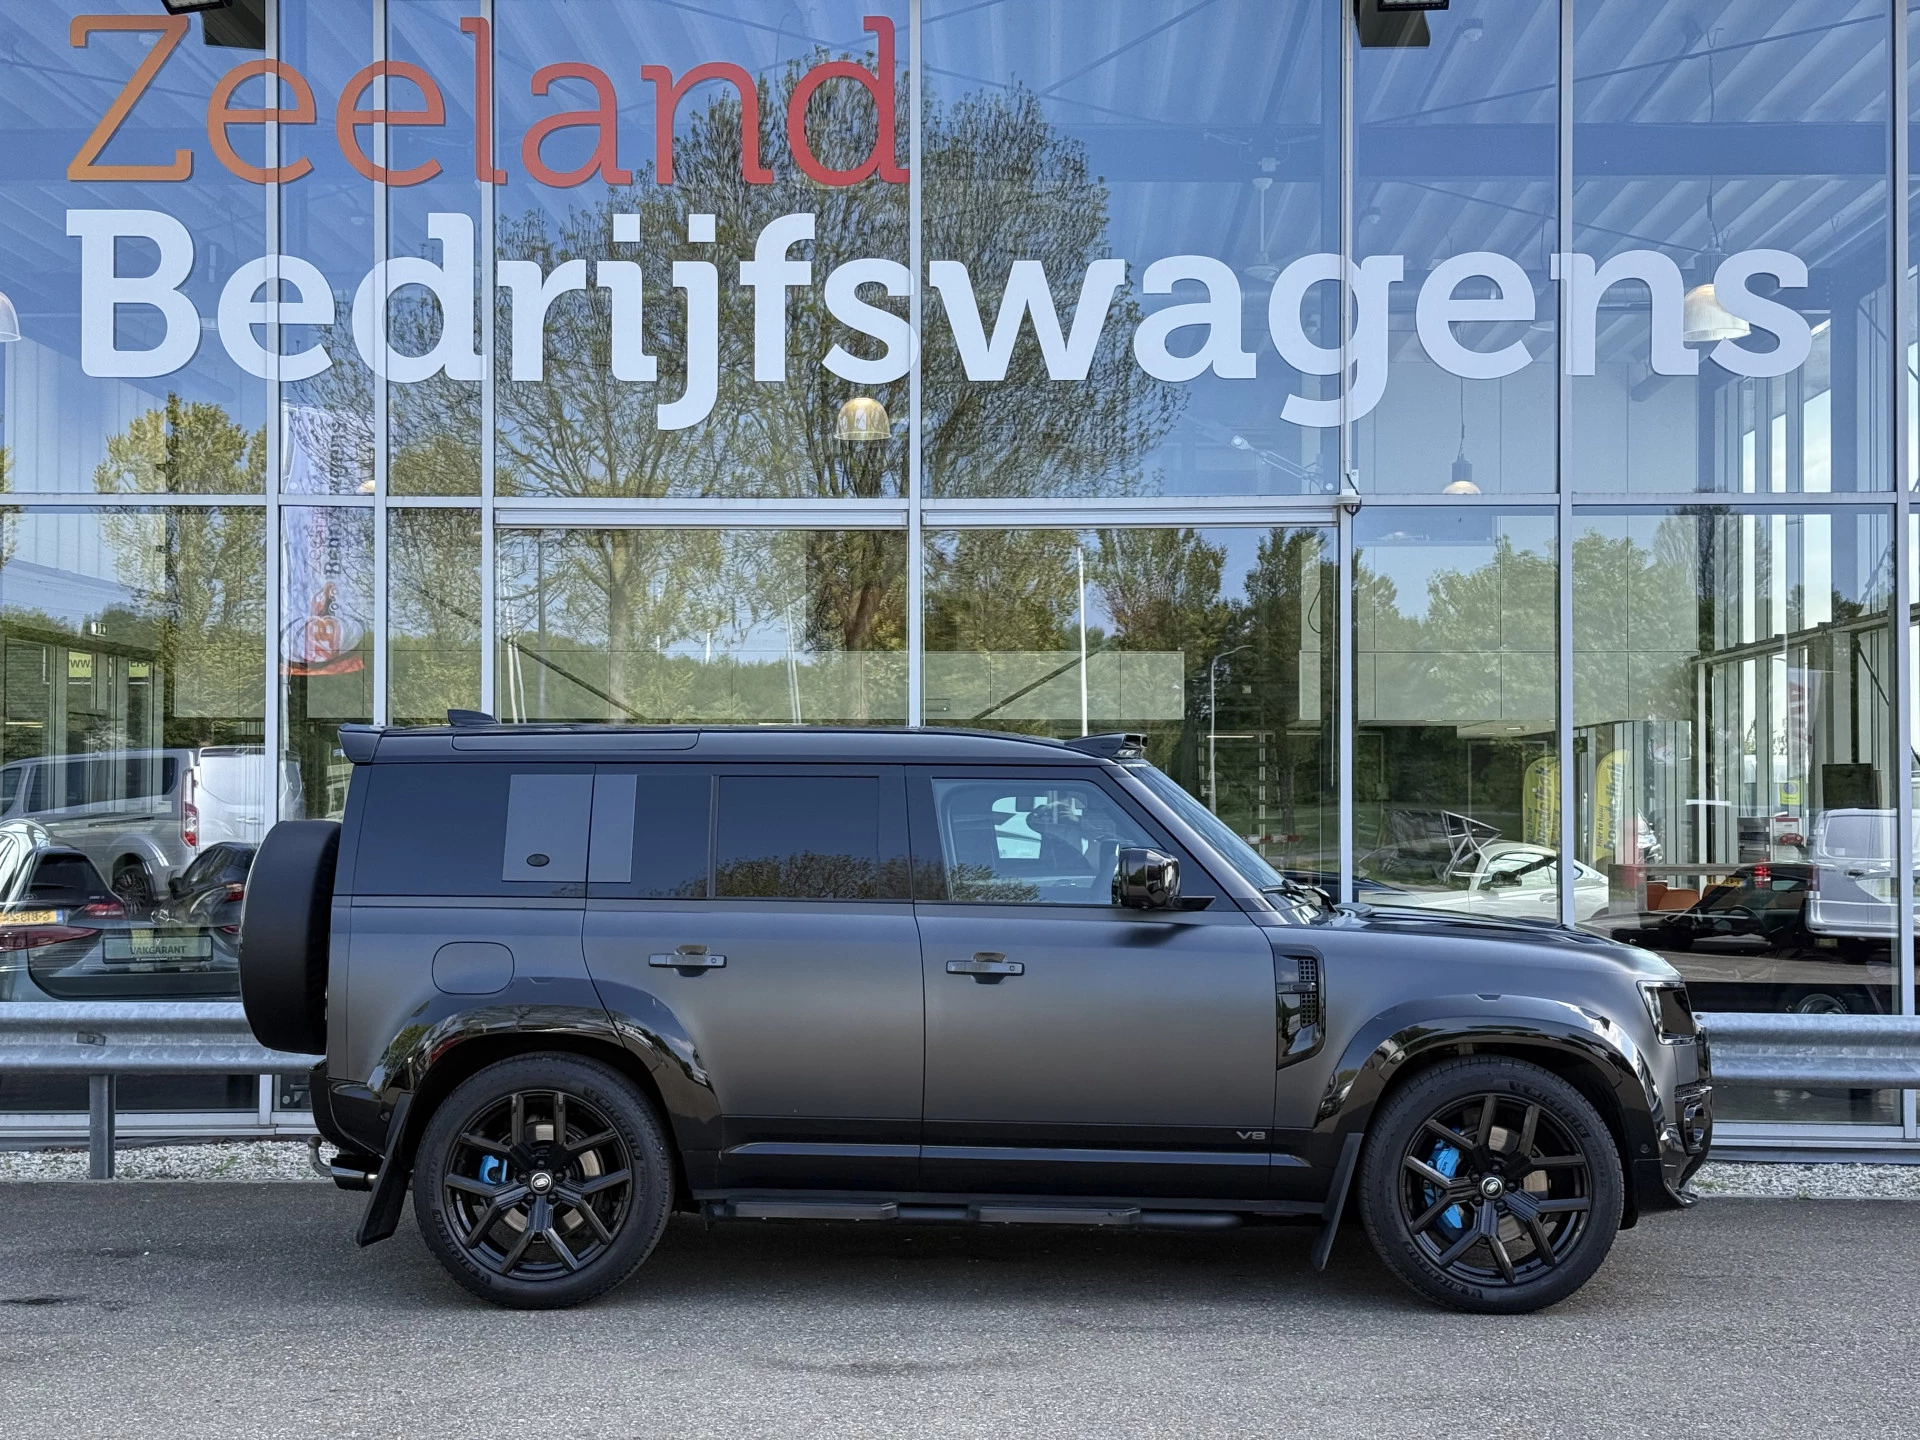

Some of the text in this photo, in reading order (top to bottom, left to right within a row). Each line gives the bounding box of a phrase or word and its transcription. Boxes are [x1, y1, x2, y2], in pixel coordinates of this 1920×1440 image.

[66, 14, 911, 189] Zeeland
[66, 209, 1813, 431] Bedrijfswagens
[1596, 832, 1604, 848] Hier
[129, 945, 186, 955] VAKGARANT
[1236, 1131, 1266, 1140] V8
[1404, 1243, 1465, 1291] MICHELIN
